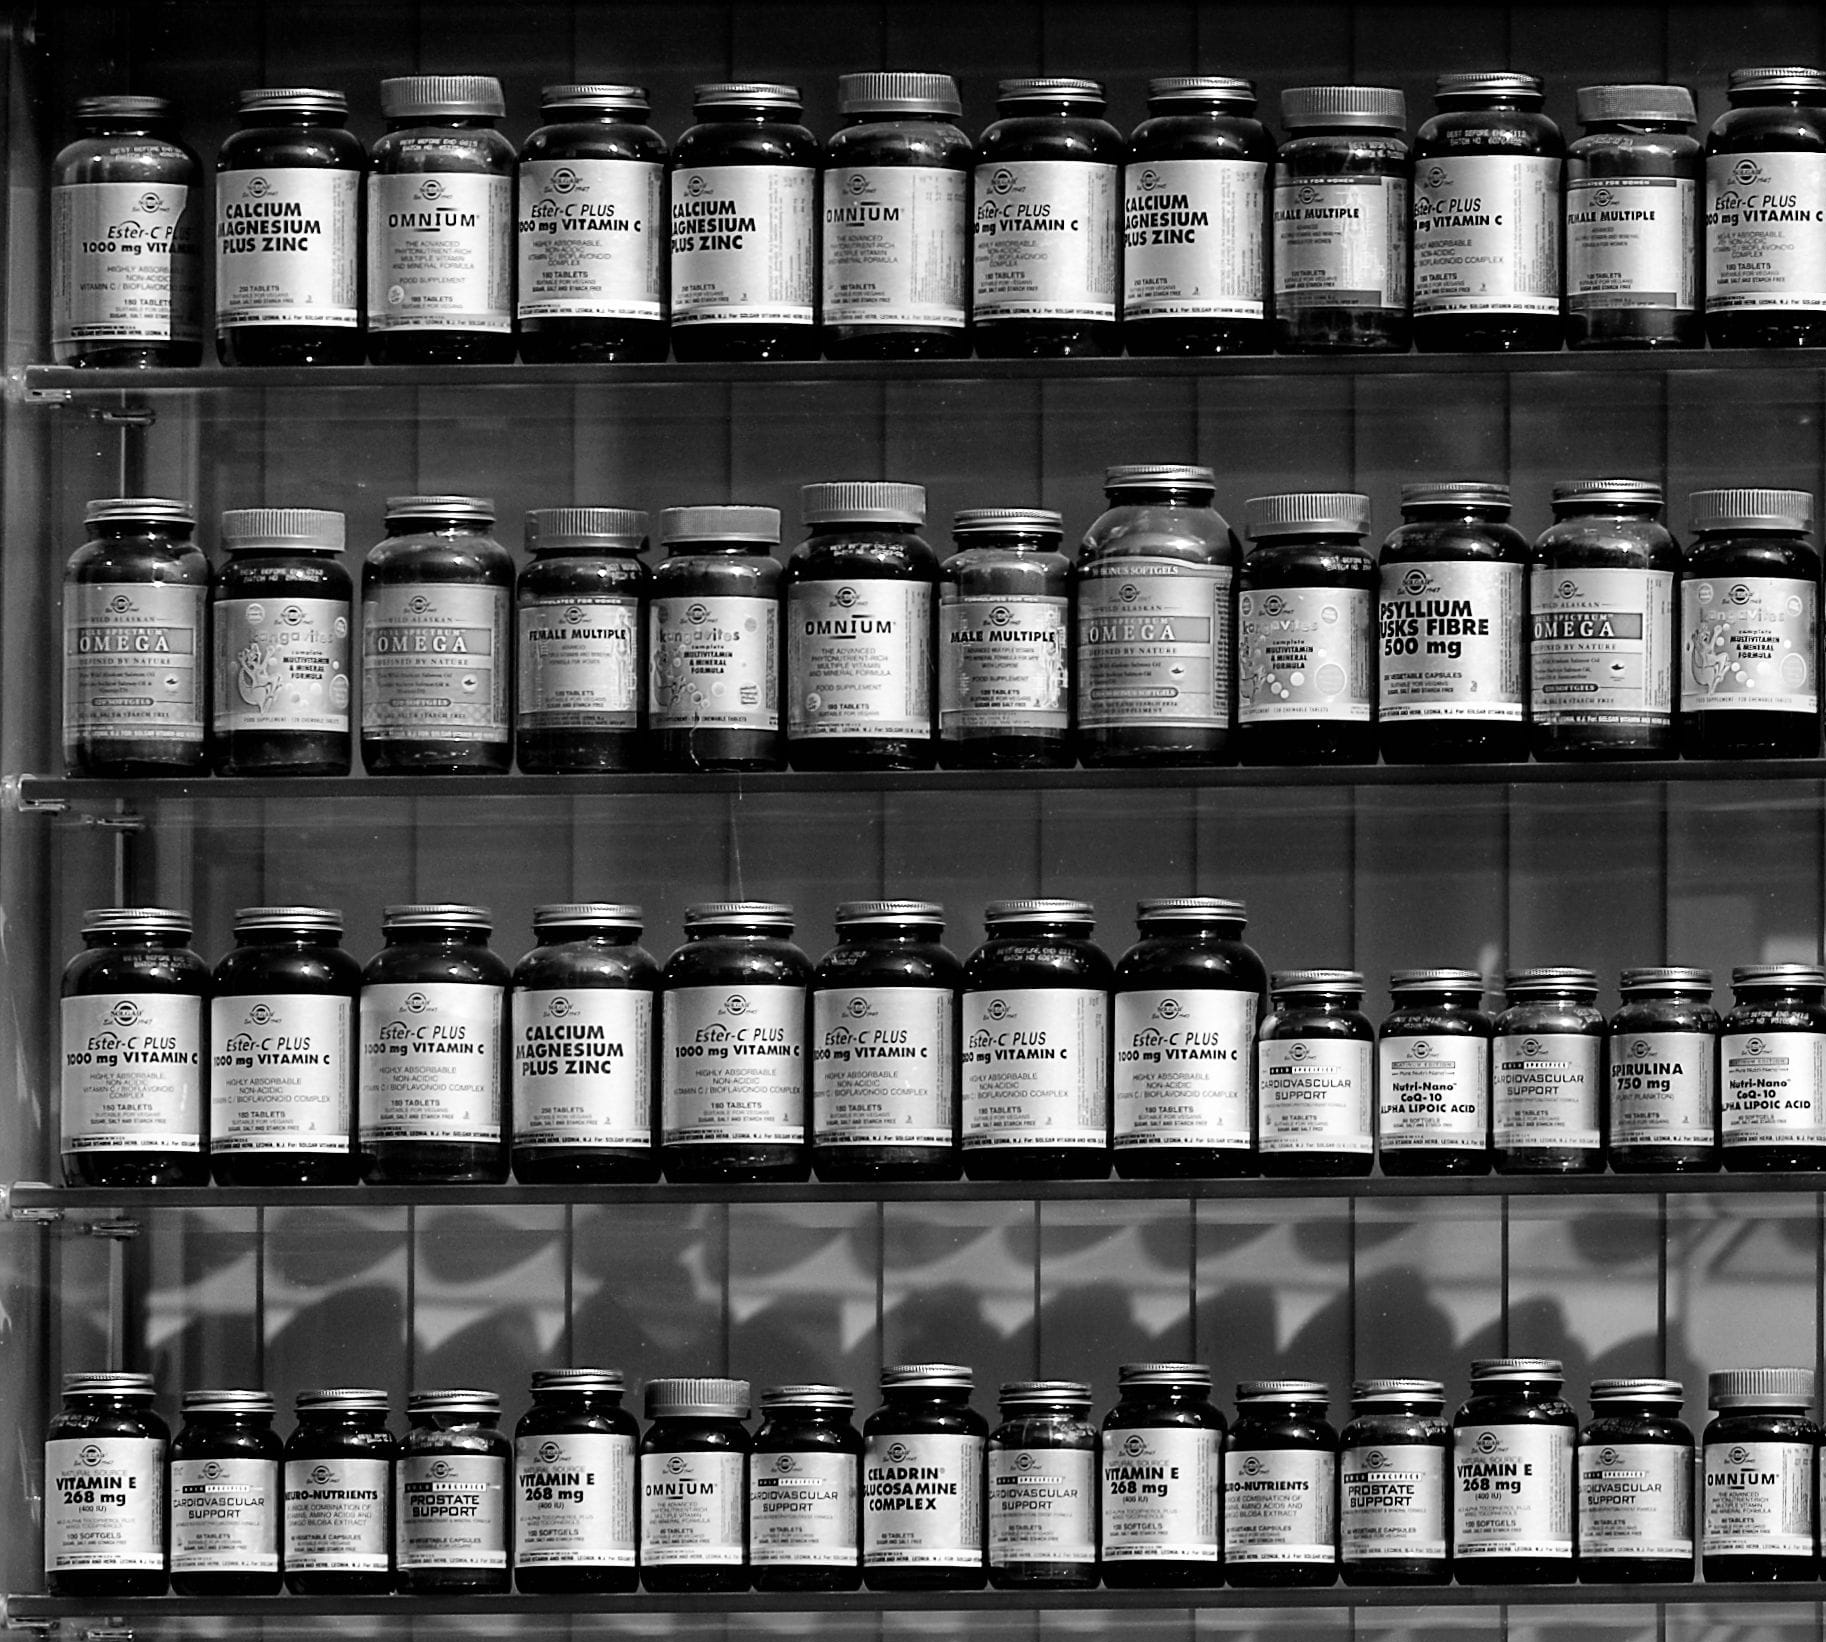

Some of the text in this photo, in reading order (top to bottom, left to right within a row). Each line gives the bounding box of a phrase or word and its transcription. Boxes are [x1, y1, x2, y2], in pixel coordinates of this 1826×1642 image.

[226, 203, 301, 219] CALCIUM
[531, 199, 614, 218] Ester-C PLUS
[562, 219, 641, 232] VITAMIN C
[223, 237, 307, 254] PLUS ZINC
[1381, 600, 1472, 620] PSYLLIUM
[529, 627, 626, 642] FEMALE MULTIPLE
[1535, 620, 1615, 637] OMEGA
[1385, 637, 1461, 659] 500 mg
[88, 1031, 176, 1050] Ester-C PLUS
[526, 1025, 604, 1041] CALCIUM
[67, 1052, 197, 1067] 1000 mg VITAMIN C
[523, 1060, 610, 1076] PLUS ZINC
[1612, 1063, 1683, 1077] SPIRULINA
[1618, 1077, 1670, 1092] 750 mg
[1401, 1093, 1442, 1102] CoQ-10
[56, 1477, 136, 1490] VITAMIN E
[1349, 1485, 1414, 1496] PROSTATE
[64, 1491, 125, 1506] 268 mg
[1351, 1496, 1412, 1508] SUPPORT
